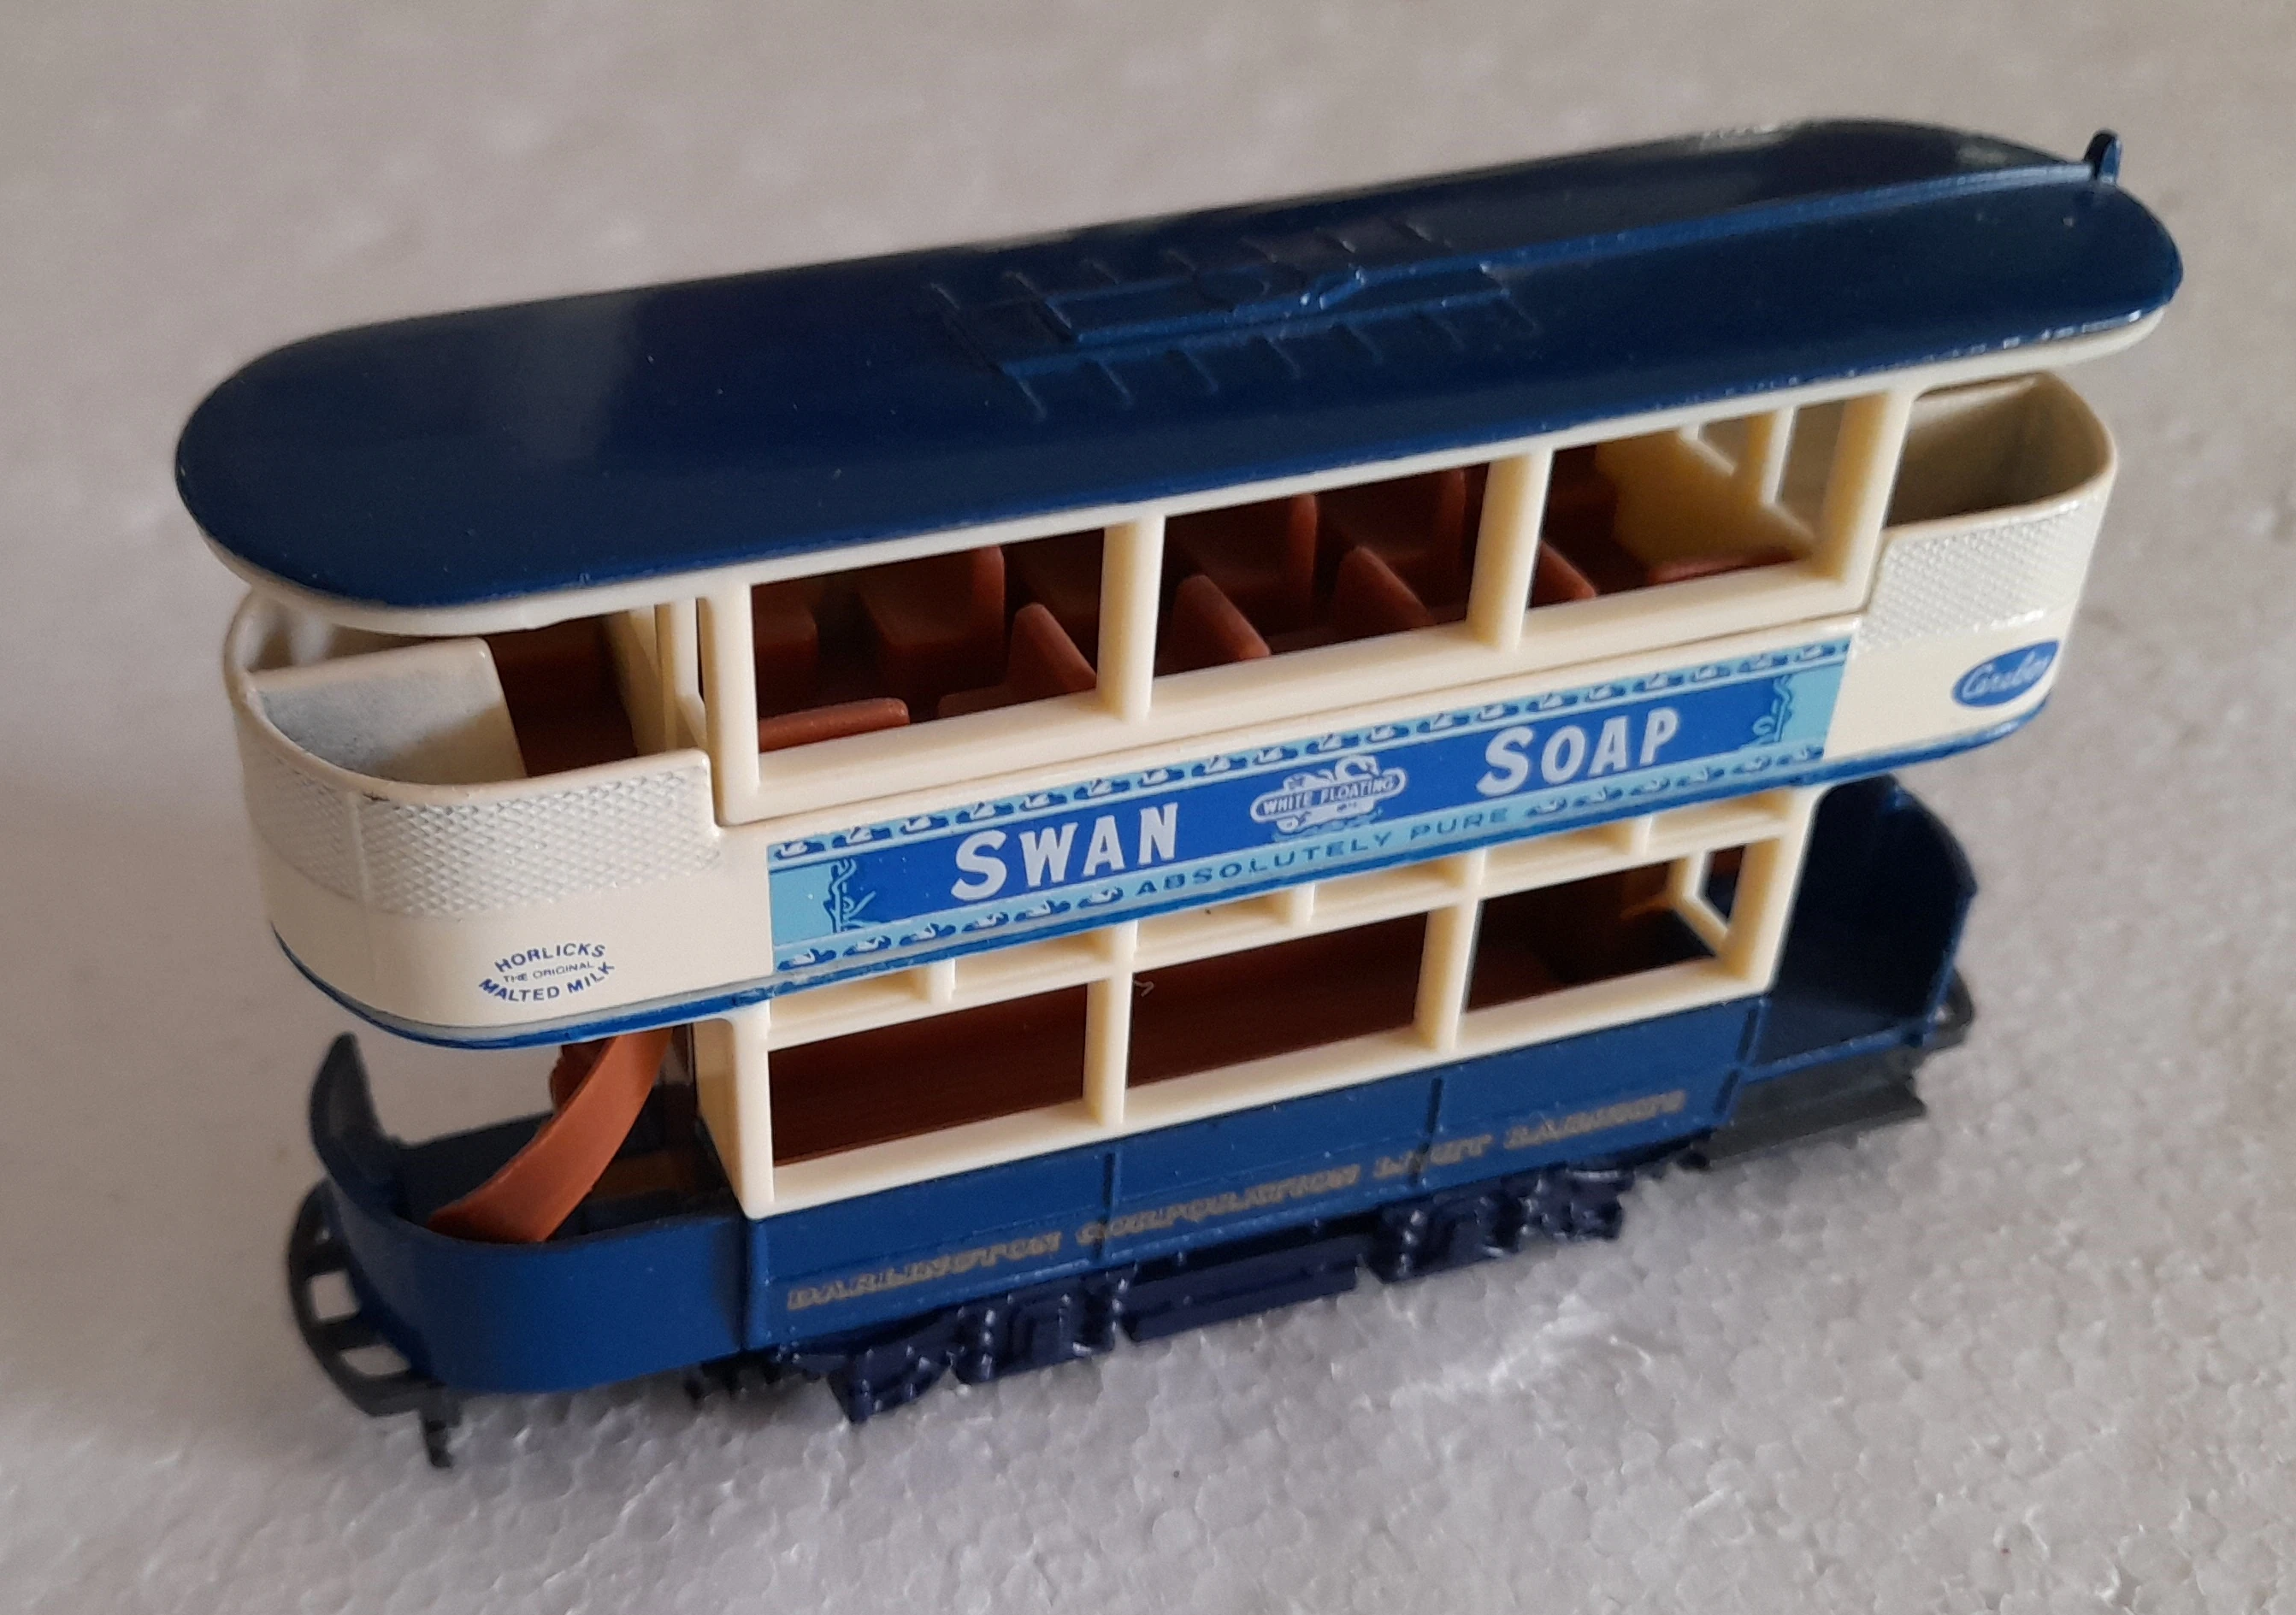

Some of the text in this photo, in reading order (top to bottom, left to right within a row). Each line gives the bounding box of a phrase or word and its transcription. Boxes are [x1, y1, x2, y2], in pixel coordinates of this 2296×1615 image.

[951, 706, 1679, 901] SWAN SOAP
[1262, 775, 1395, 815] WHITE FLOATING
[1136, 807, 1509, 894] ABSOLUTELY PURE
[494, 942, 606, 973] HORLICKS
[503, 961, 595, 983] THE ORIGINAL
[478, 961, 616, 1002] MALTED MILK
